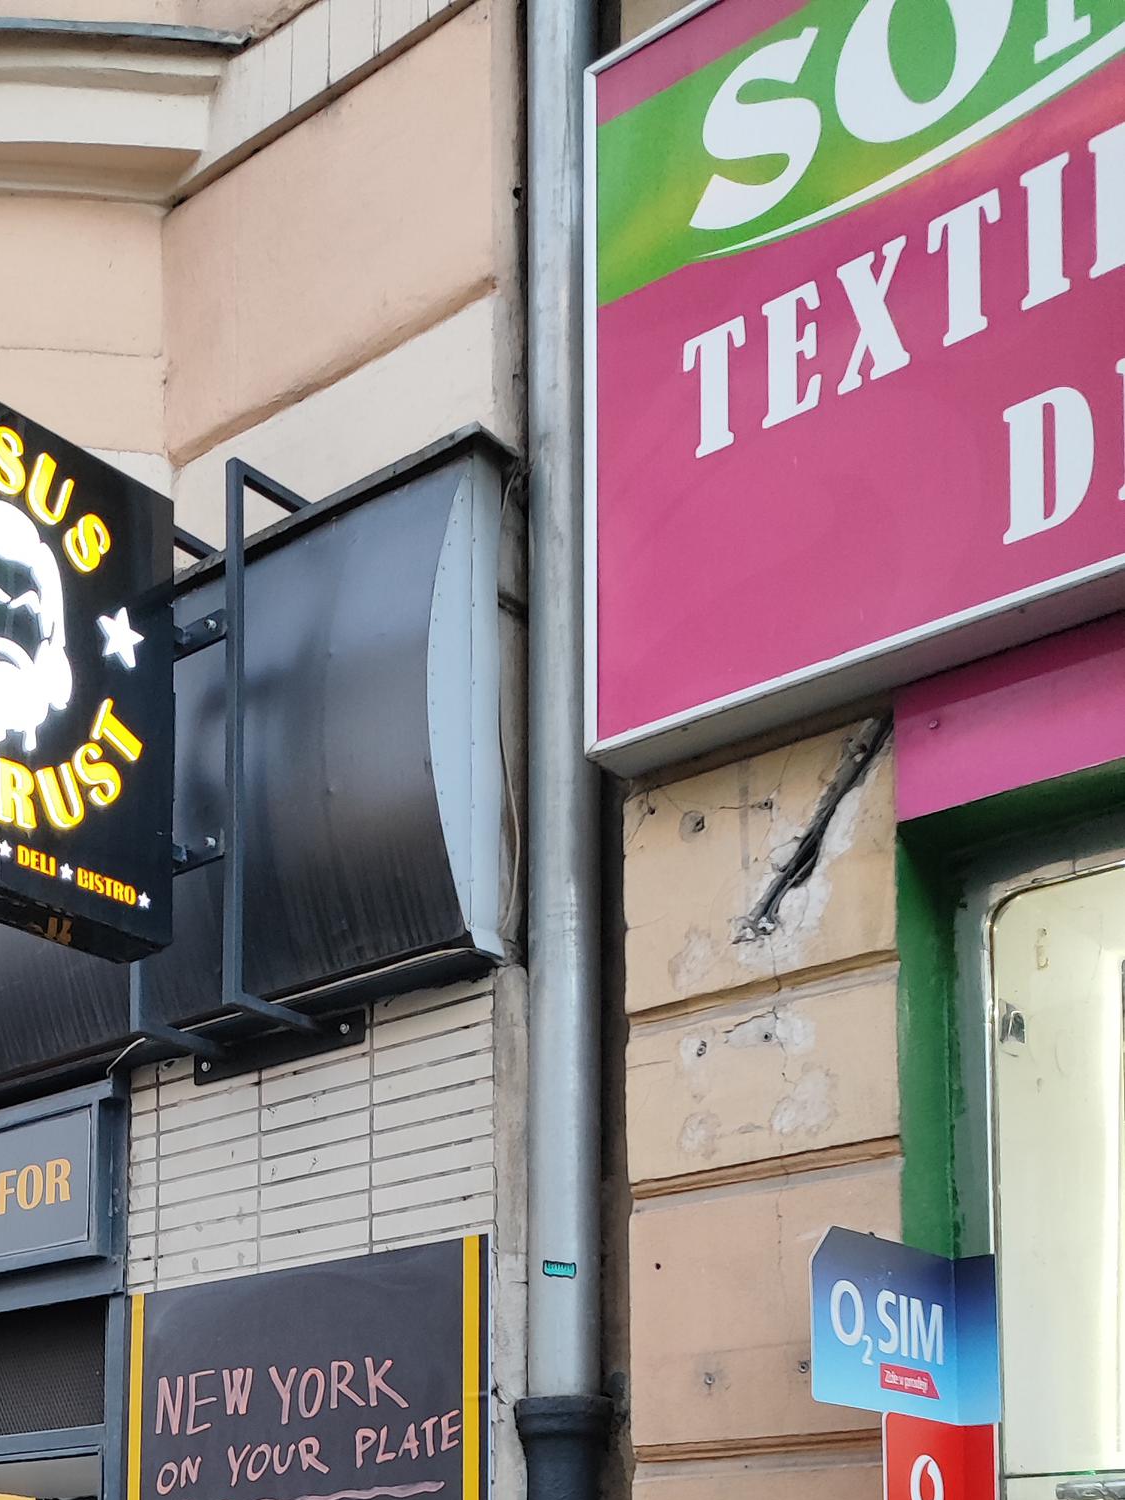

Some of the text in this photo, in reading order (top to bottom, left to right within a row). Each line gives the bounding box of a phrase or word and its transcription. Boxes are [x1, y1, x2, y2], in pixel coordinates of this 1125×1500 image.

[1002, 358, 1125, 545] D
[16, 844, 57, 878] DELI
[76, 866, 138, 907] BISTRO
[875, 1287, 945, 1366] SIM
[155, 1356, 410, 1436] NEW YORK
[155, 1408, 462, 1496] ON YOUR PLATE
